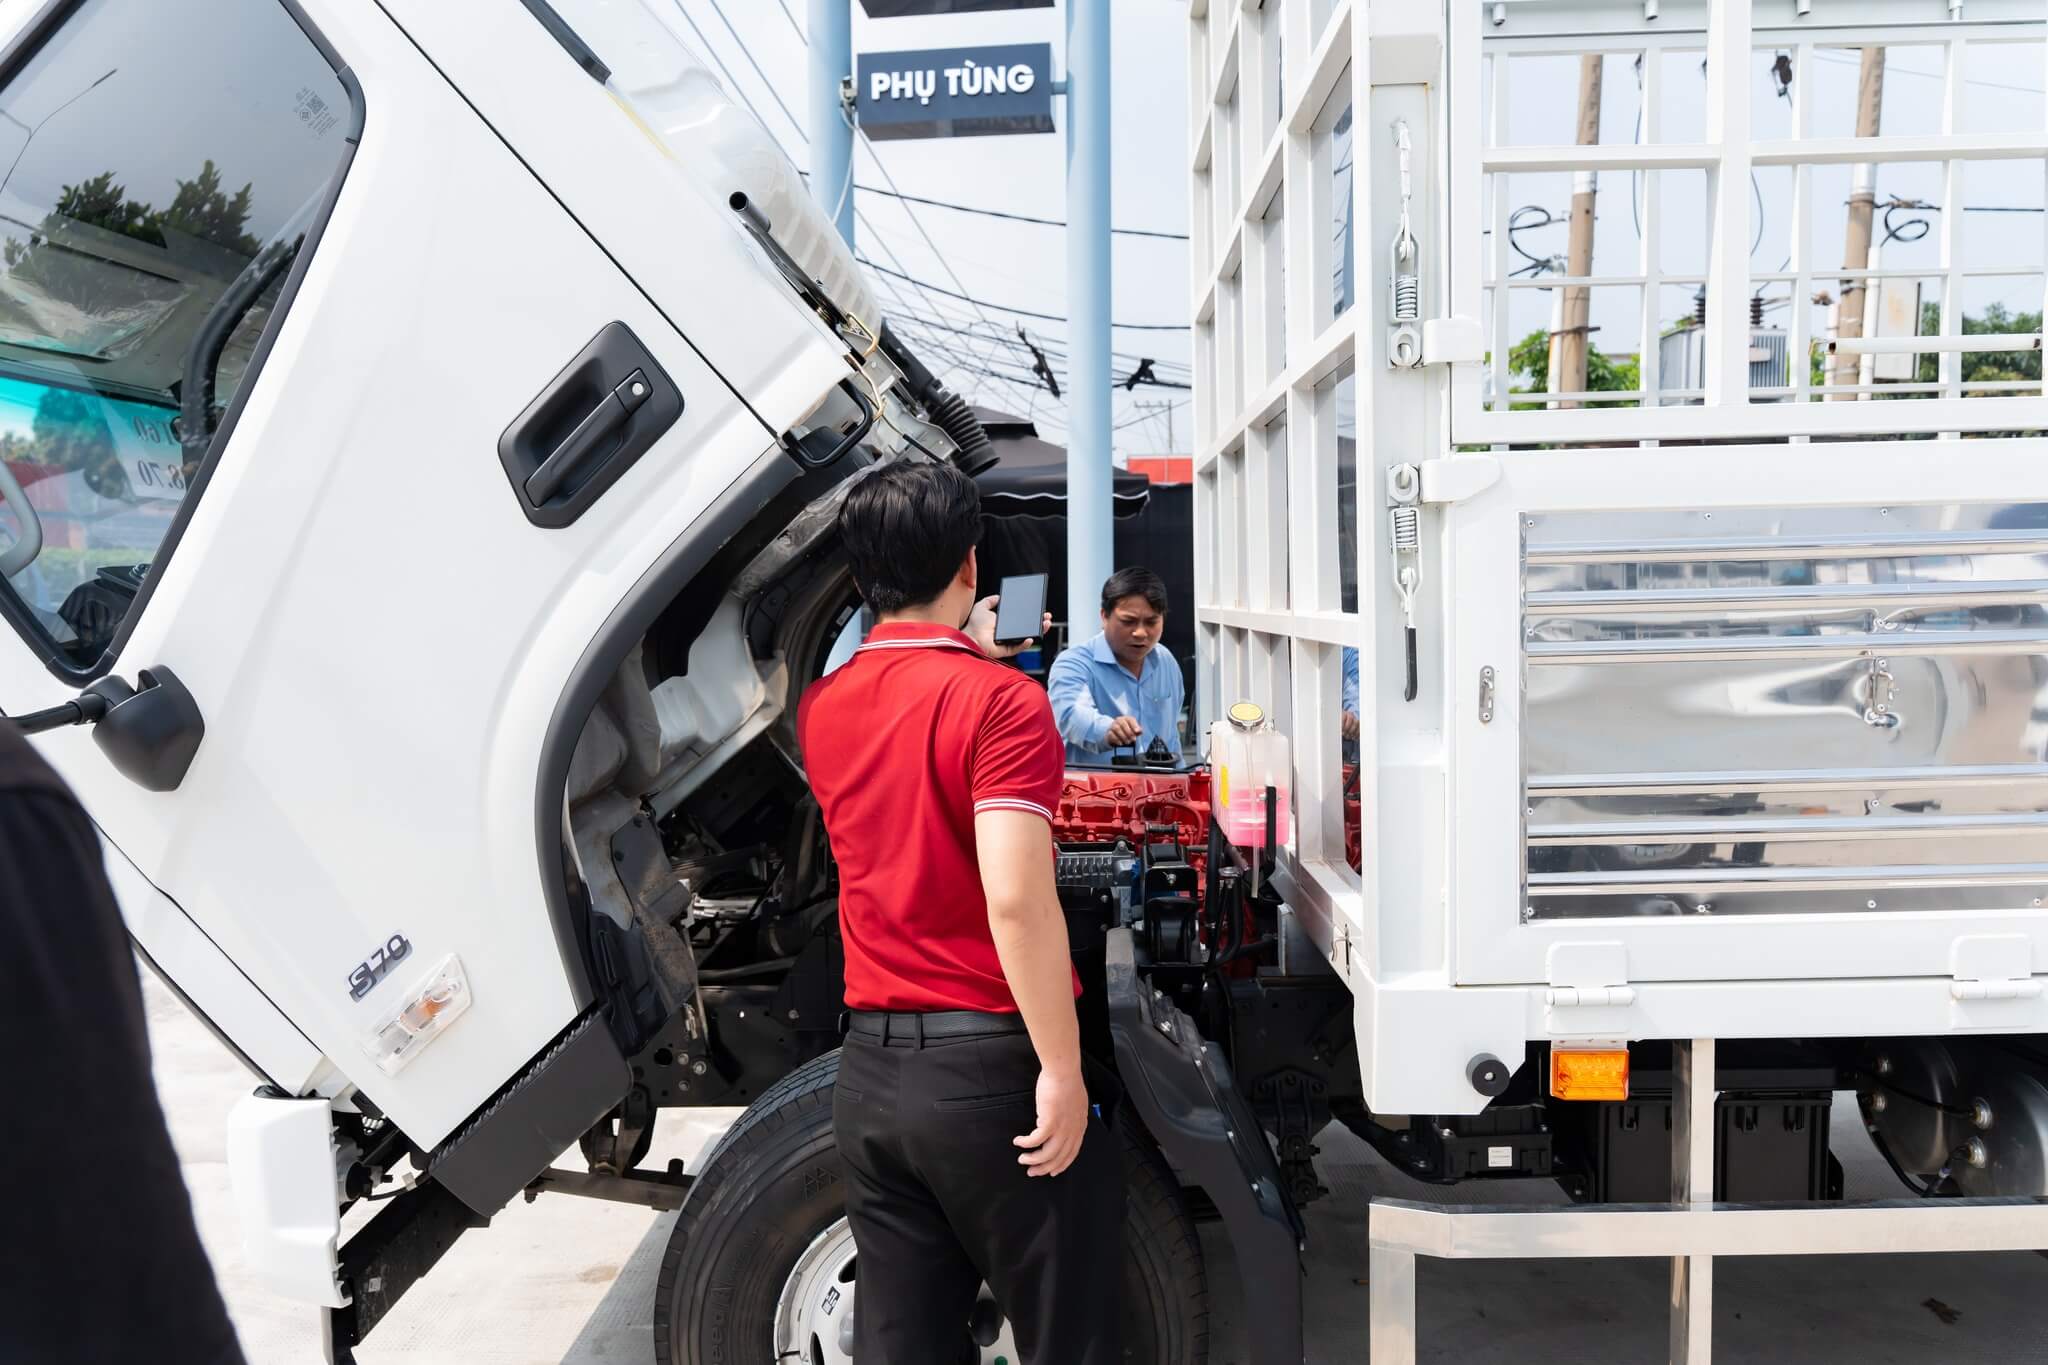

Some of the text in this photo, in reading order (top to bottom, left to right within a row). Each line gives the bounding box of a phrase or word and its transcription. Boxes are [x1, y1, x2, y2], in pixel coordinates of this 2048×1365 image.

[870, 59, 1035, 106] PHỤ TÙNG
[348, 934, 412, 1001] S70
